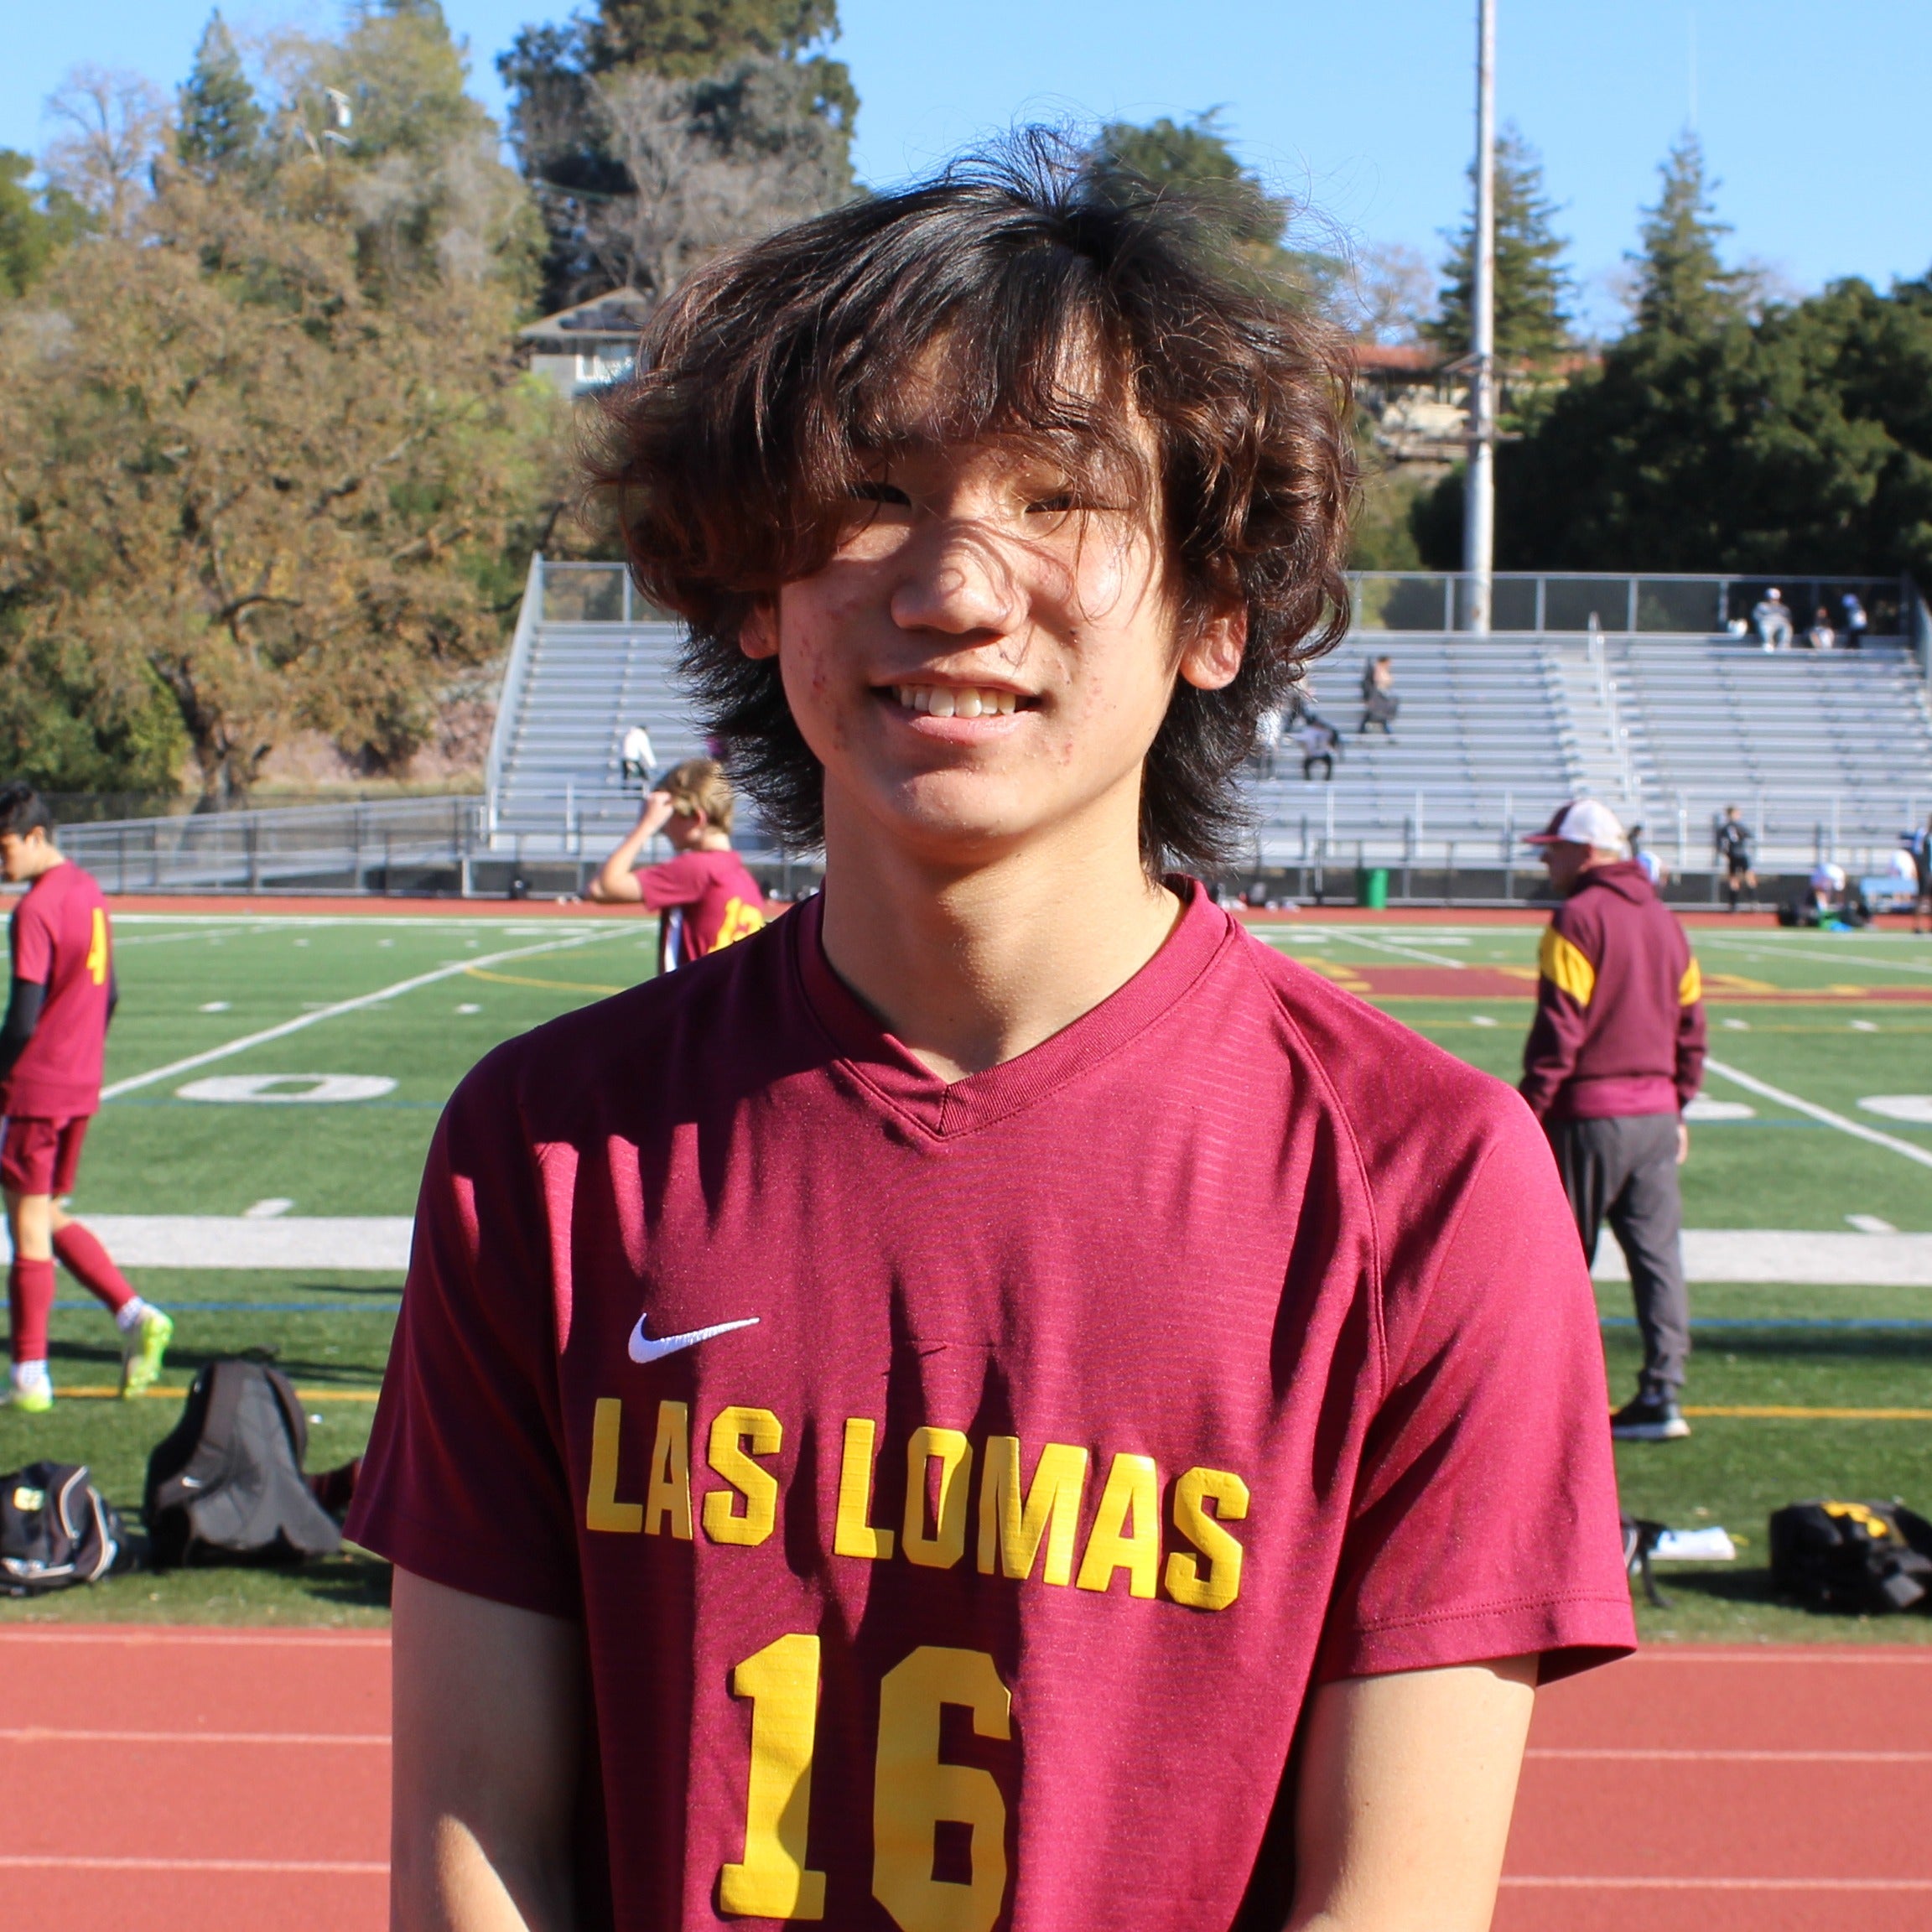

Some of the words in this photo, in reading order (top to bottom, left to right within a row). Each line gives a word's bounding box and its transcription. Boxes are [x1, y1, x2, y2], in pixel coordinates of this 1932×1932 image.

[587, 1397, 783, 1546] LAS
[834, 1417, 1250, 1610] LOMAS
[720, 1633, 1012, 1932] 16
